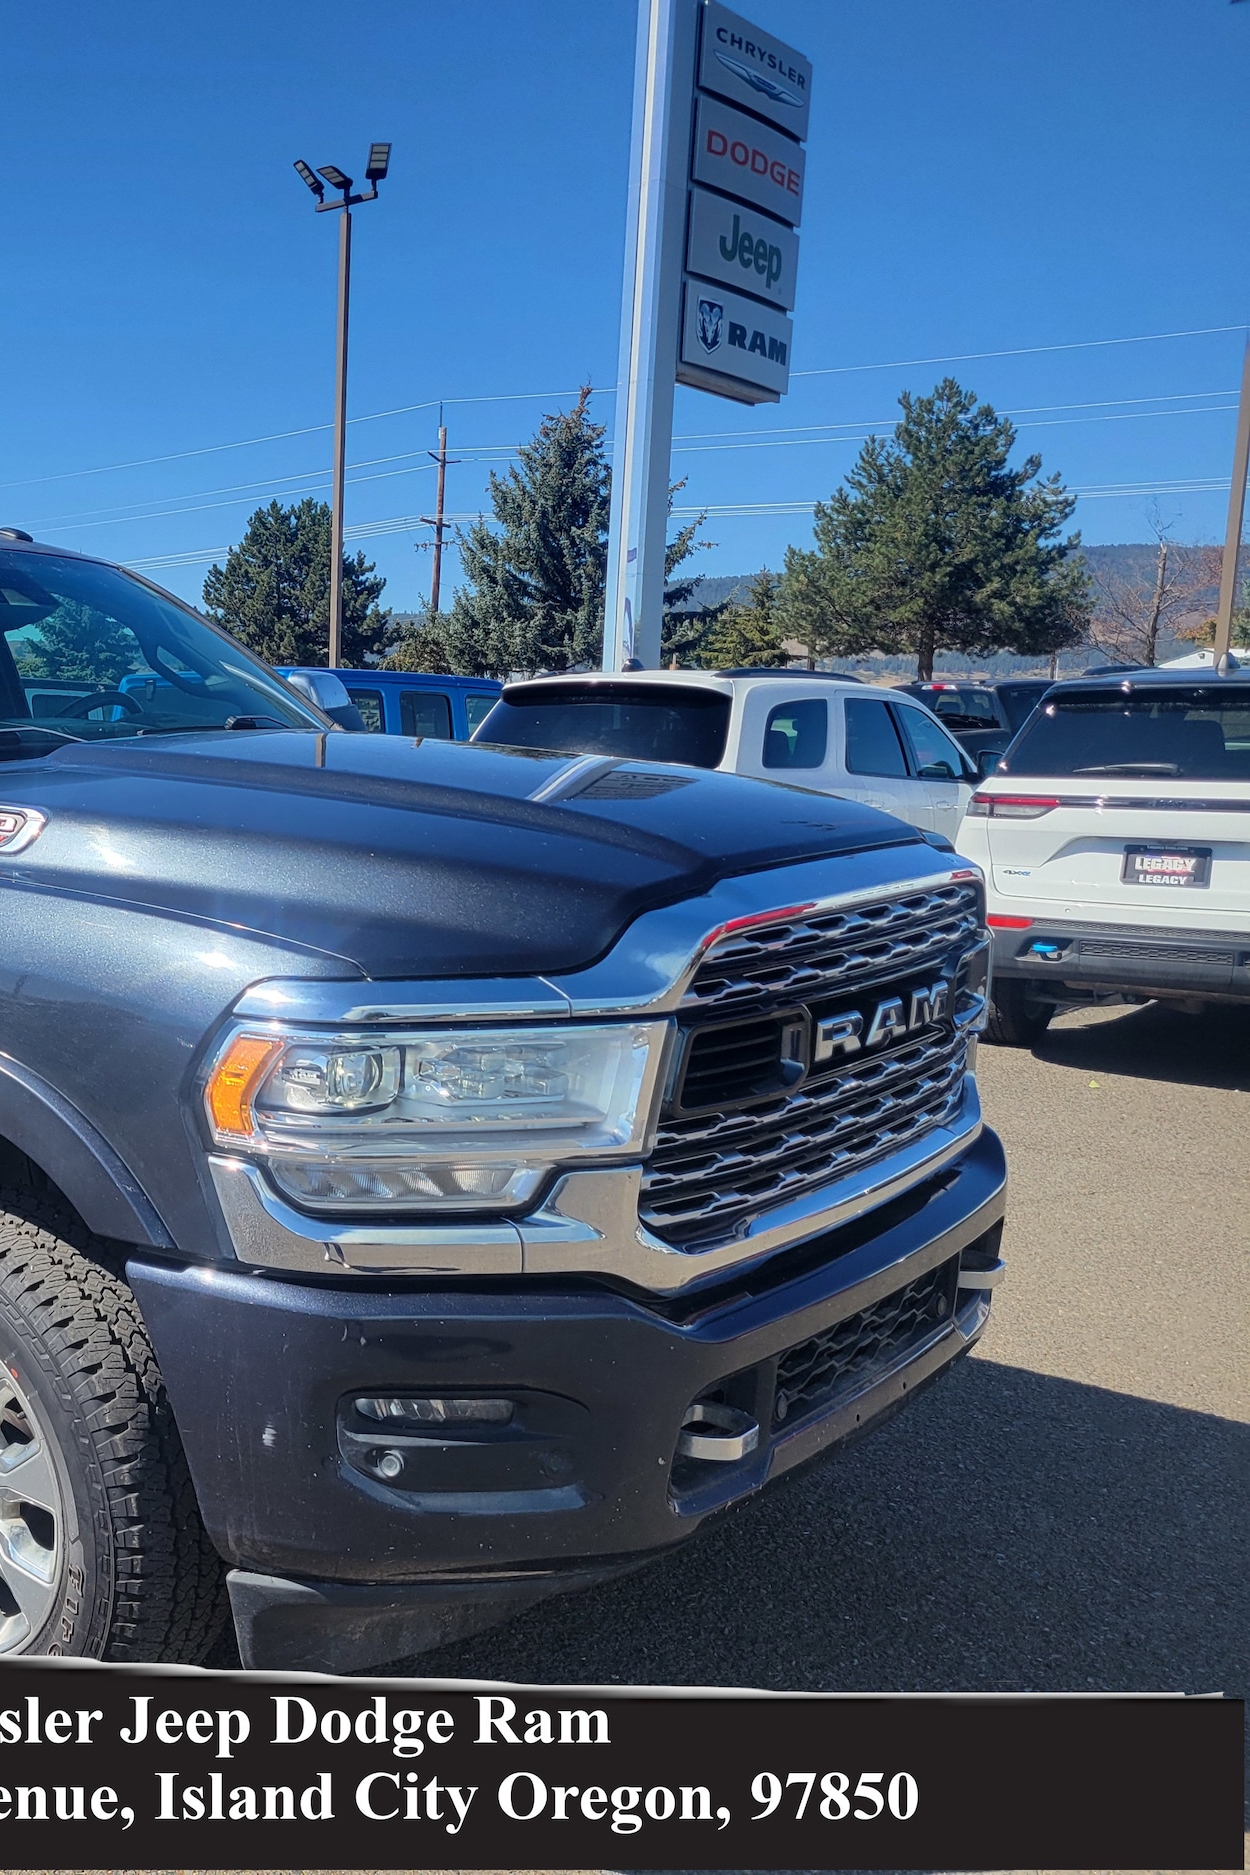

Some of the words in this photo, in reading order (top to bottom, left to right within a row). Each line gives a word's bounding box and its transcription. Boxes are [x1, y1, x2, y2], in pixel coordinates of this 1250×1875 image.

[715, 27, 806, 90] CHRYSLER
[707, 129, 800, 198] DODGE
[719, 214, 782, 289] Jeep
[728, 321, 788, 366] RAM
[1134, 856, 1197, 873] LEGACY
[1138, 874, 1188, 885] LEGACY
[814, 979, 949, 1062] RAM
